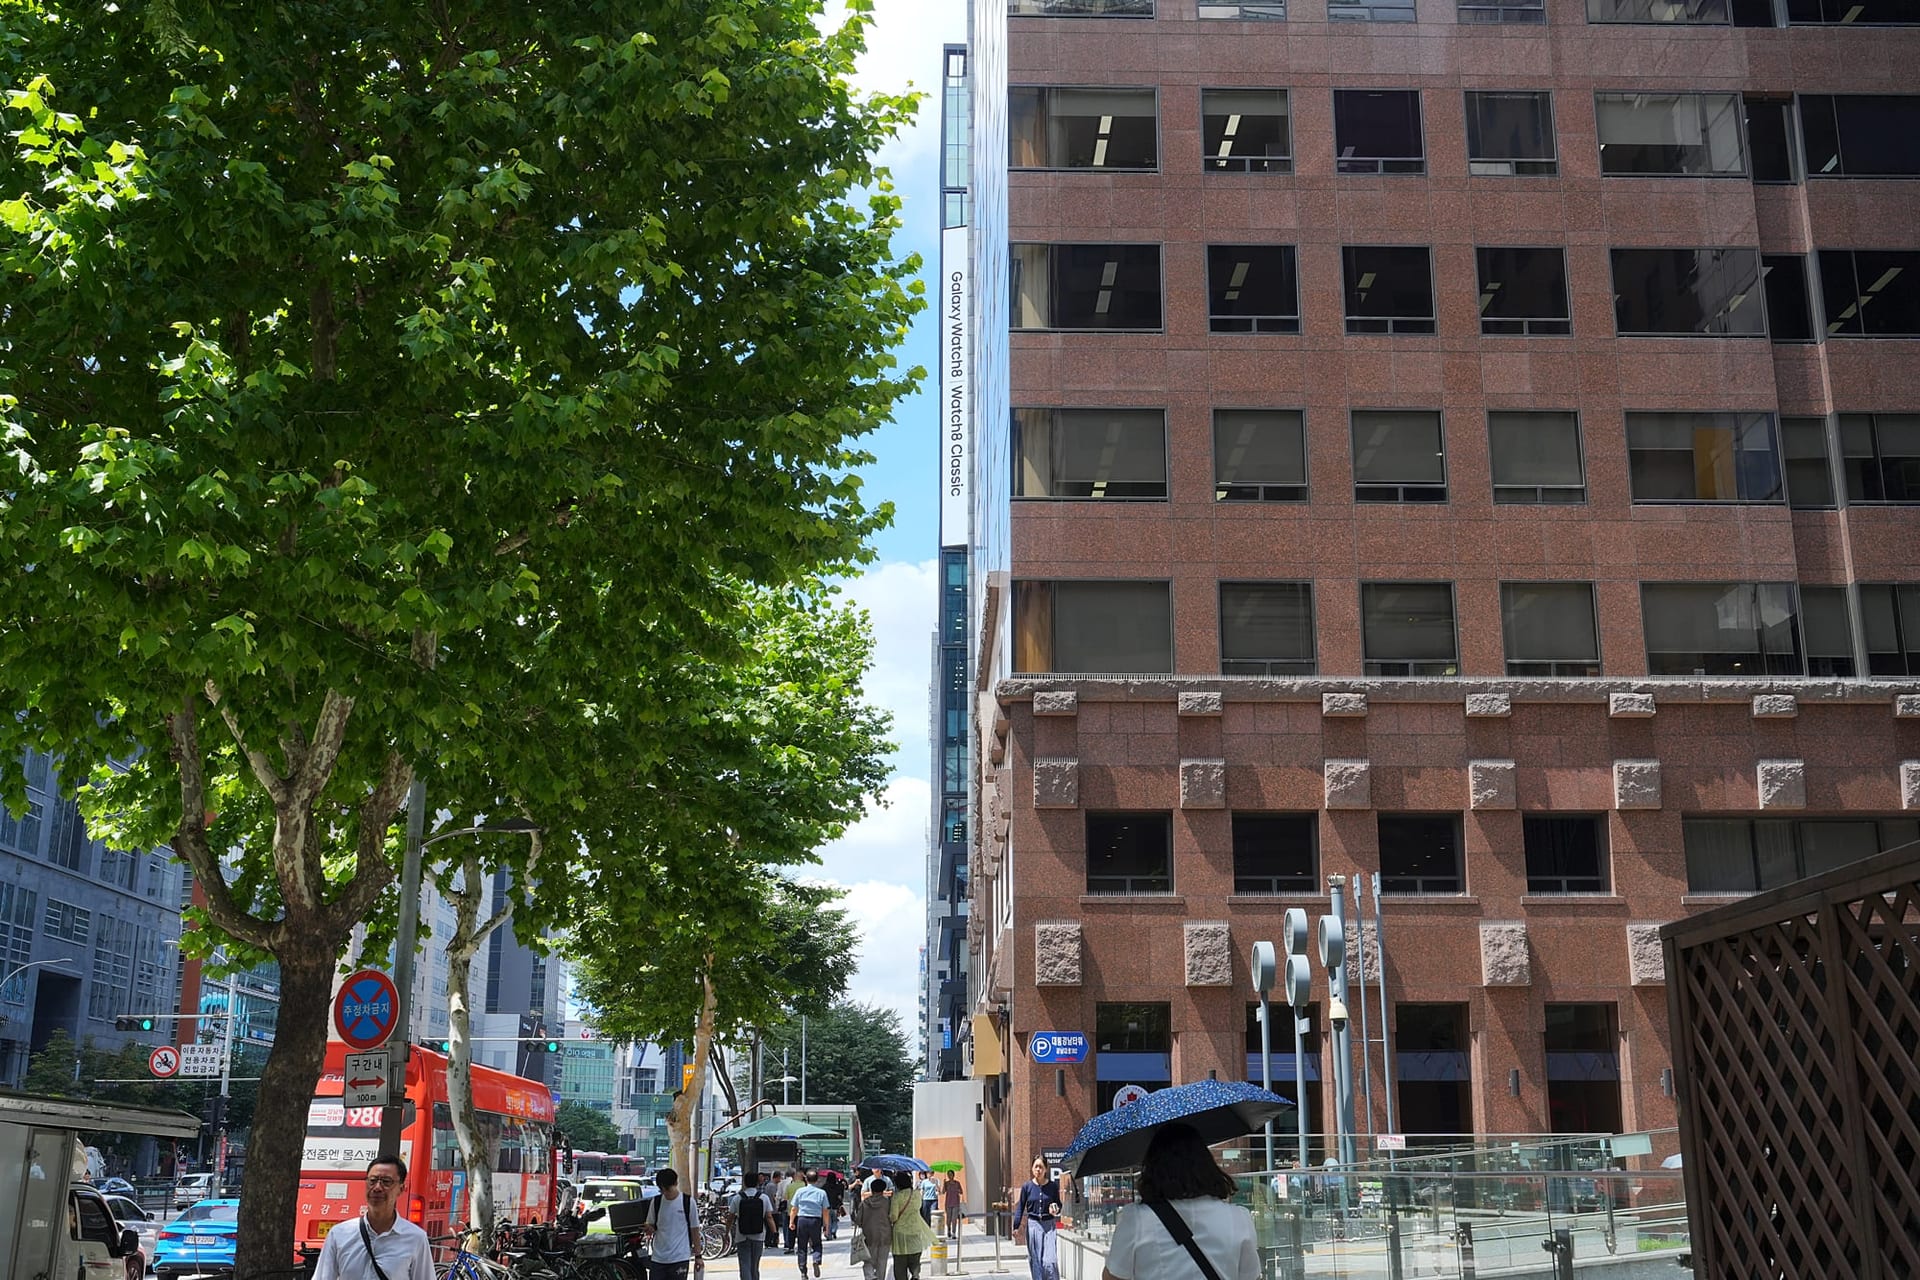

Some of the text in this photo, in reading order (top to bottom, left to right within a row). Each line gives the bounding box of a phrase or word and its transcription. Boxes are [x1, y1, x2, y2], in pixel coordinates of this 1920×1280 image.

[948, 271, 964, 496] Galaxy Watch8 Watch8 Classic
[343, 1001, 390, 1017] 주정차금지
[185, 1056, 217, 1064] 전용차로
